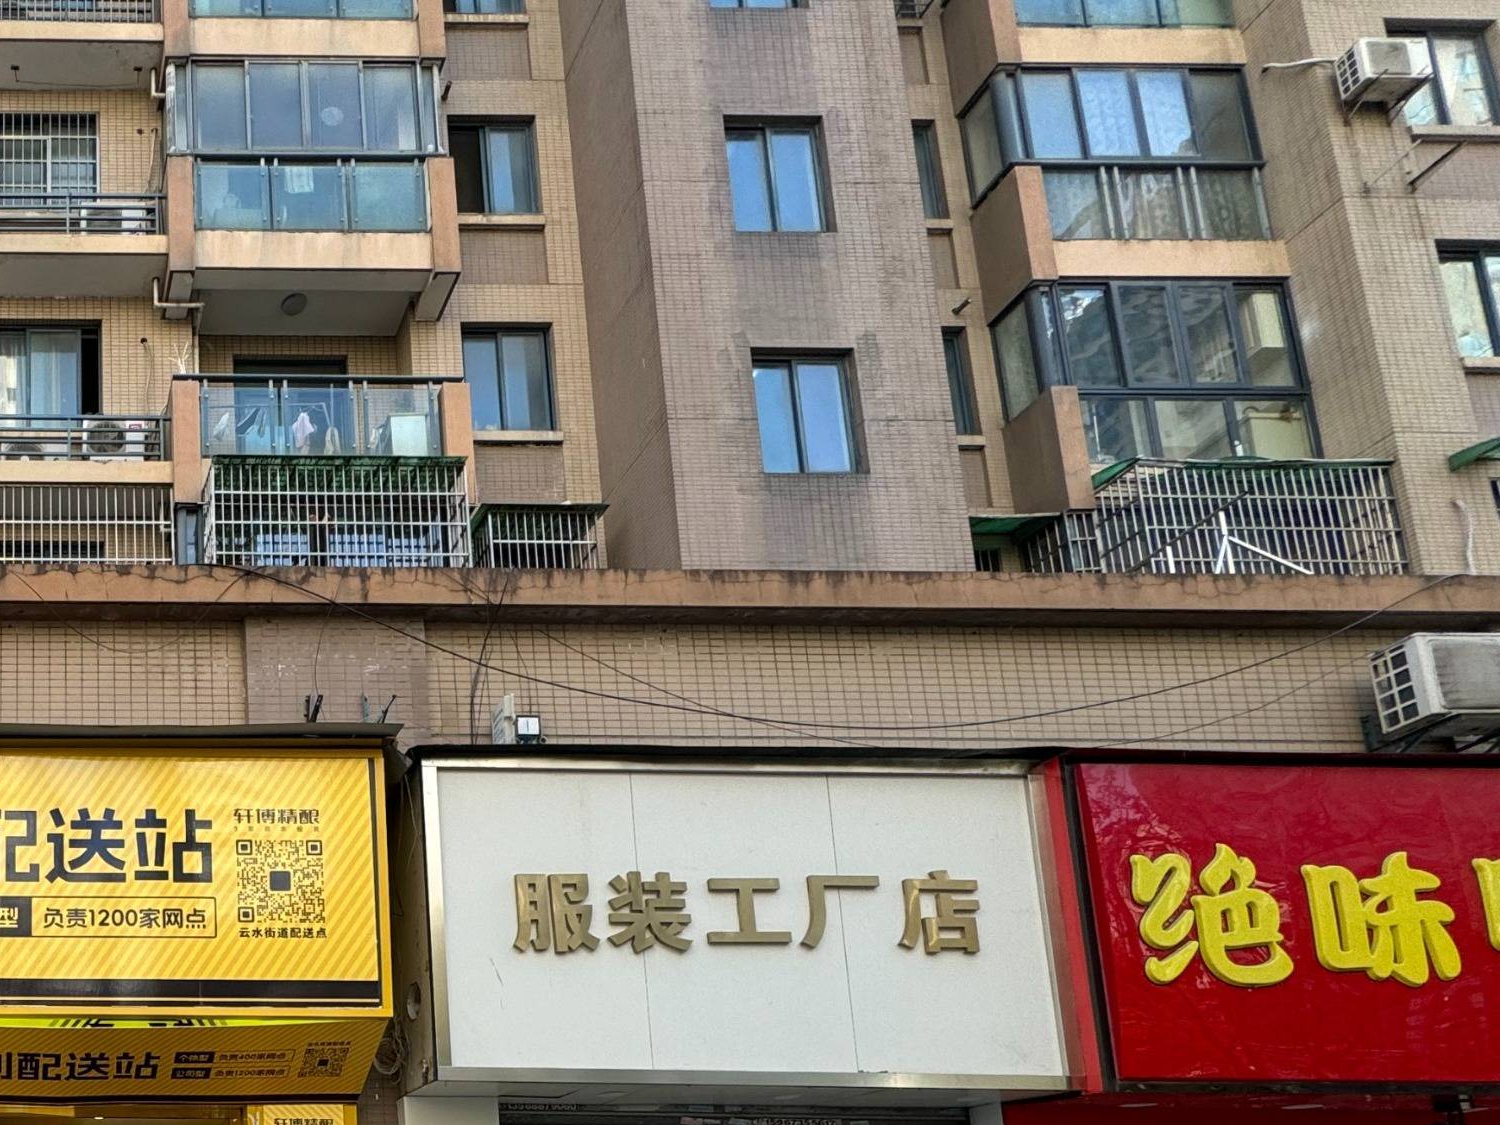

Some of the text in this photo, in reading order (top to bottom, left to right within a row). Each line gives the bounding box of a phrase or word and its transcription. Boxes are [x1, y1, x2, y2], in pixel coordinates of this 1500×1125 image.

[233, 807, 320, 824] 轩博精酿
[43, 908, 207, 930] 负责1200家网点
[512, 869, 981, 955] 服装工厂店
[1129, 842, 1500, 988] 绝味
[239, 927, 328, 939] 云水街道配送点
